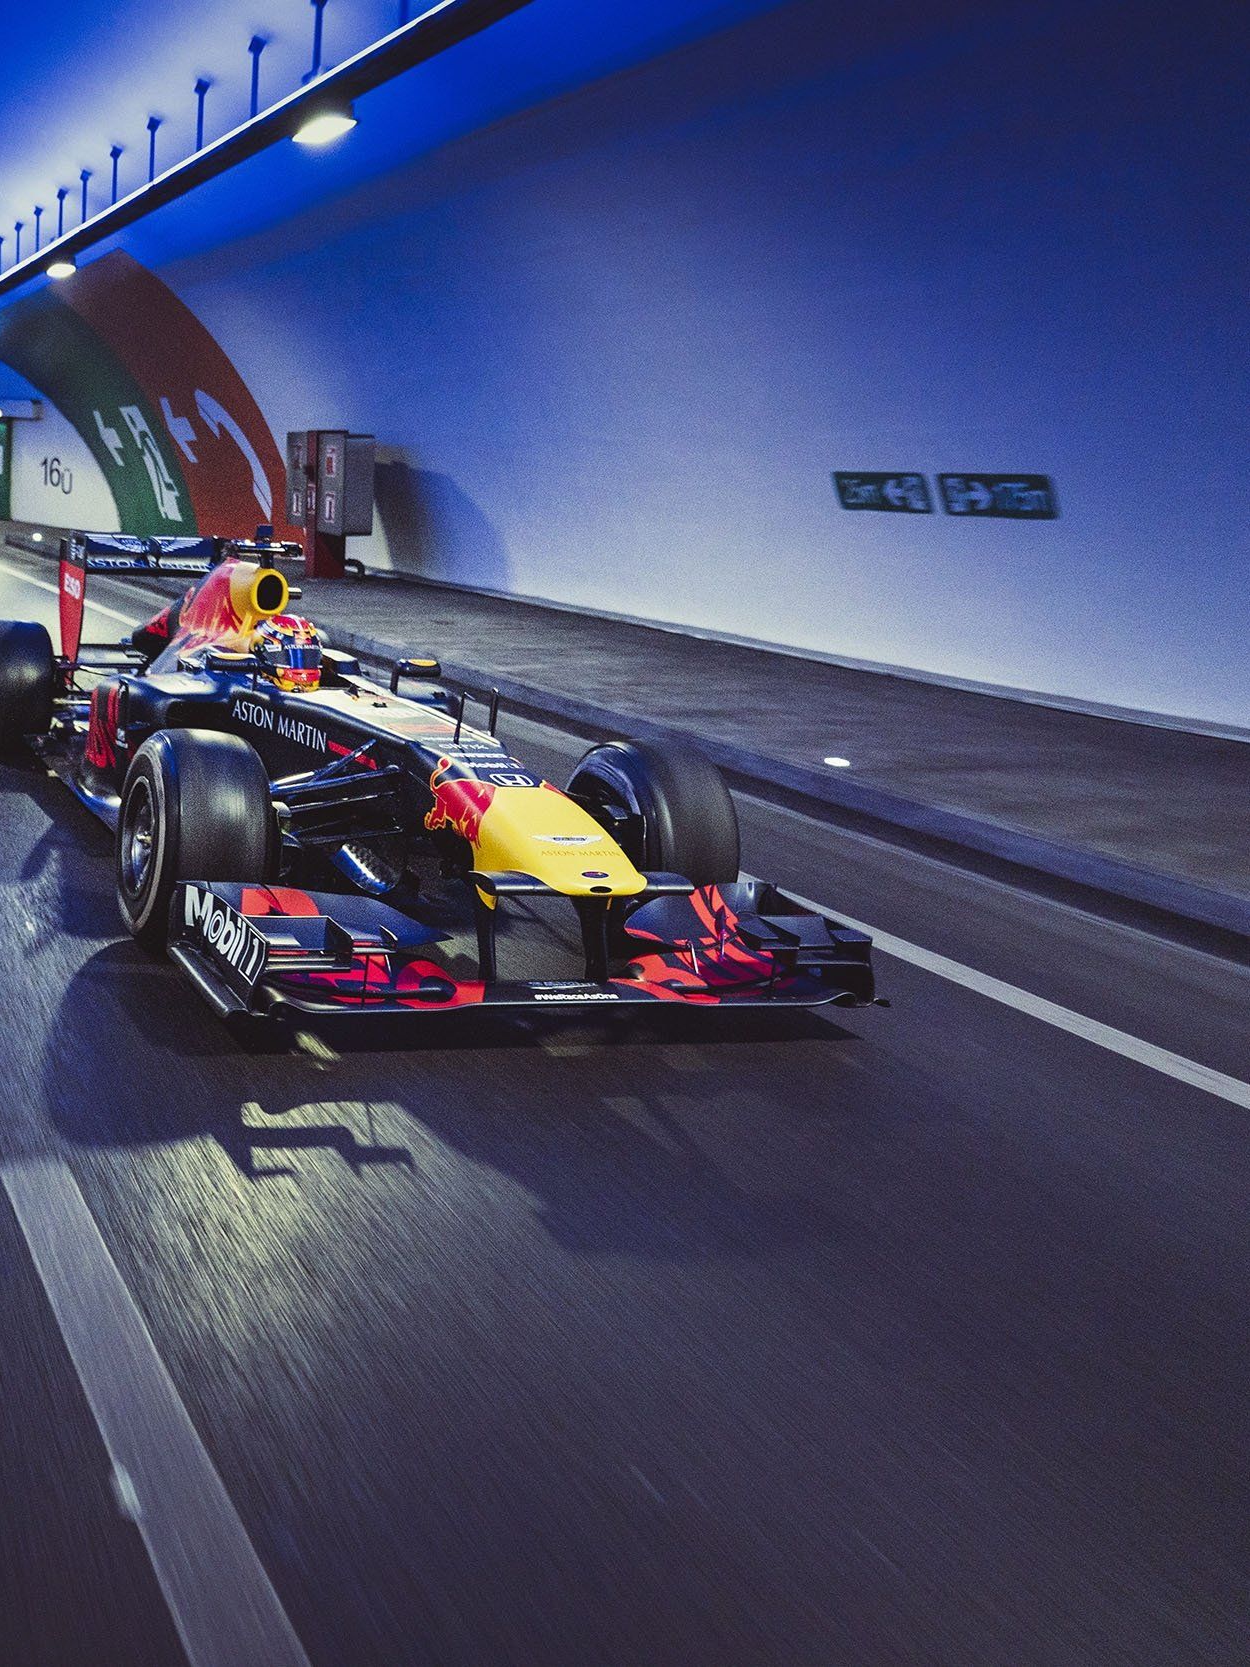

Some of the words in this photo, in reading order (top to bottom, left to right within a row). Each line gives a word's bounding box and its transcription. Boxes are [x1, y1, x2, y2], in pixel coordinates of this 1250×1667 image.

[41, 457, 72, 494] 160
[232, 699, 274, 731] ASTON
[277, 715, 327, 753] MARTIN
[185, 884, 245, 967] Mobil
